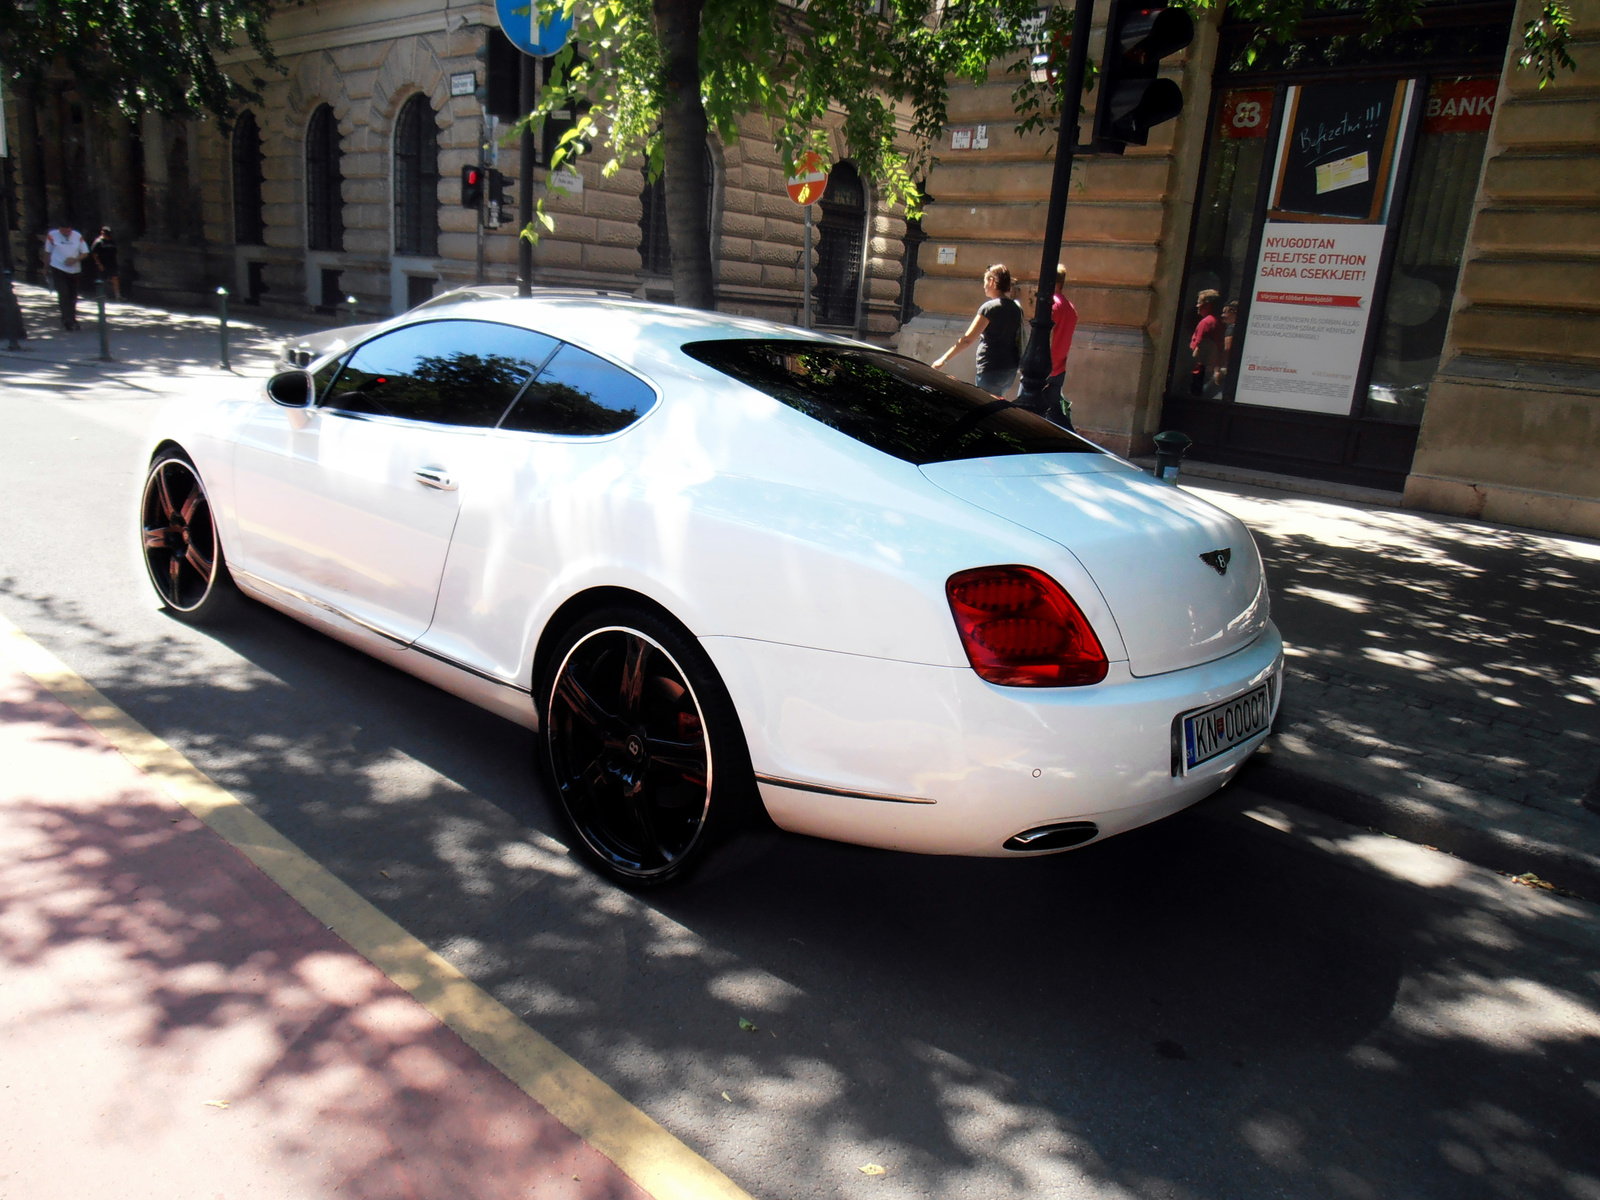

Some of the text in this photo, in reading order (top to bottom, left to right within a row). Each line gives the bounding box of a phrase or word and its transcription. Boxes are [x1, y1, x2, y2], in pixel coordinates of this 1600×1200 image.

[1427, 96, 1495, 117] BANK
[1266, 237, 1335, 249] NYUGODTAN
[1263, 252, 1366, 265] FELEJTSE OTTHON
[1260, 264, 1366, 281] SÁRGA CSEKKJEIT!
[1195, 713, 1218, 757] KN
